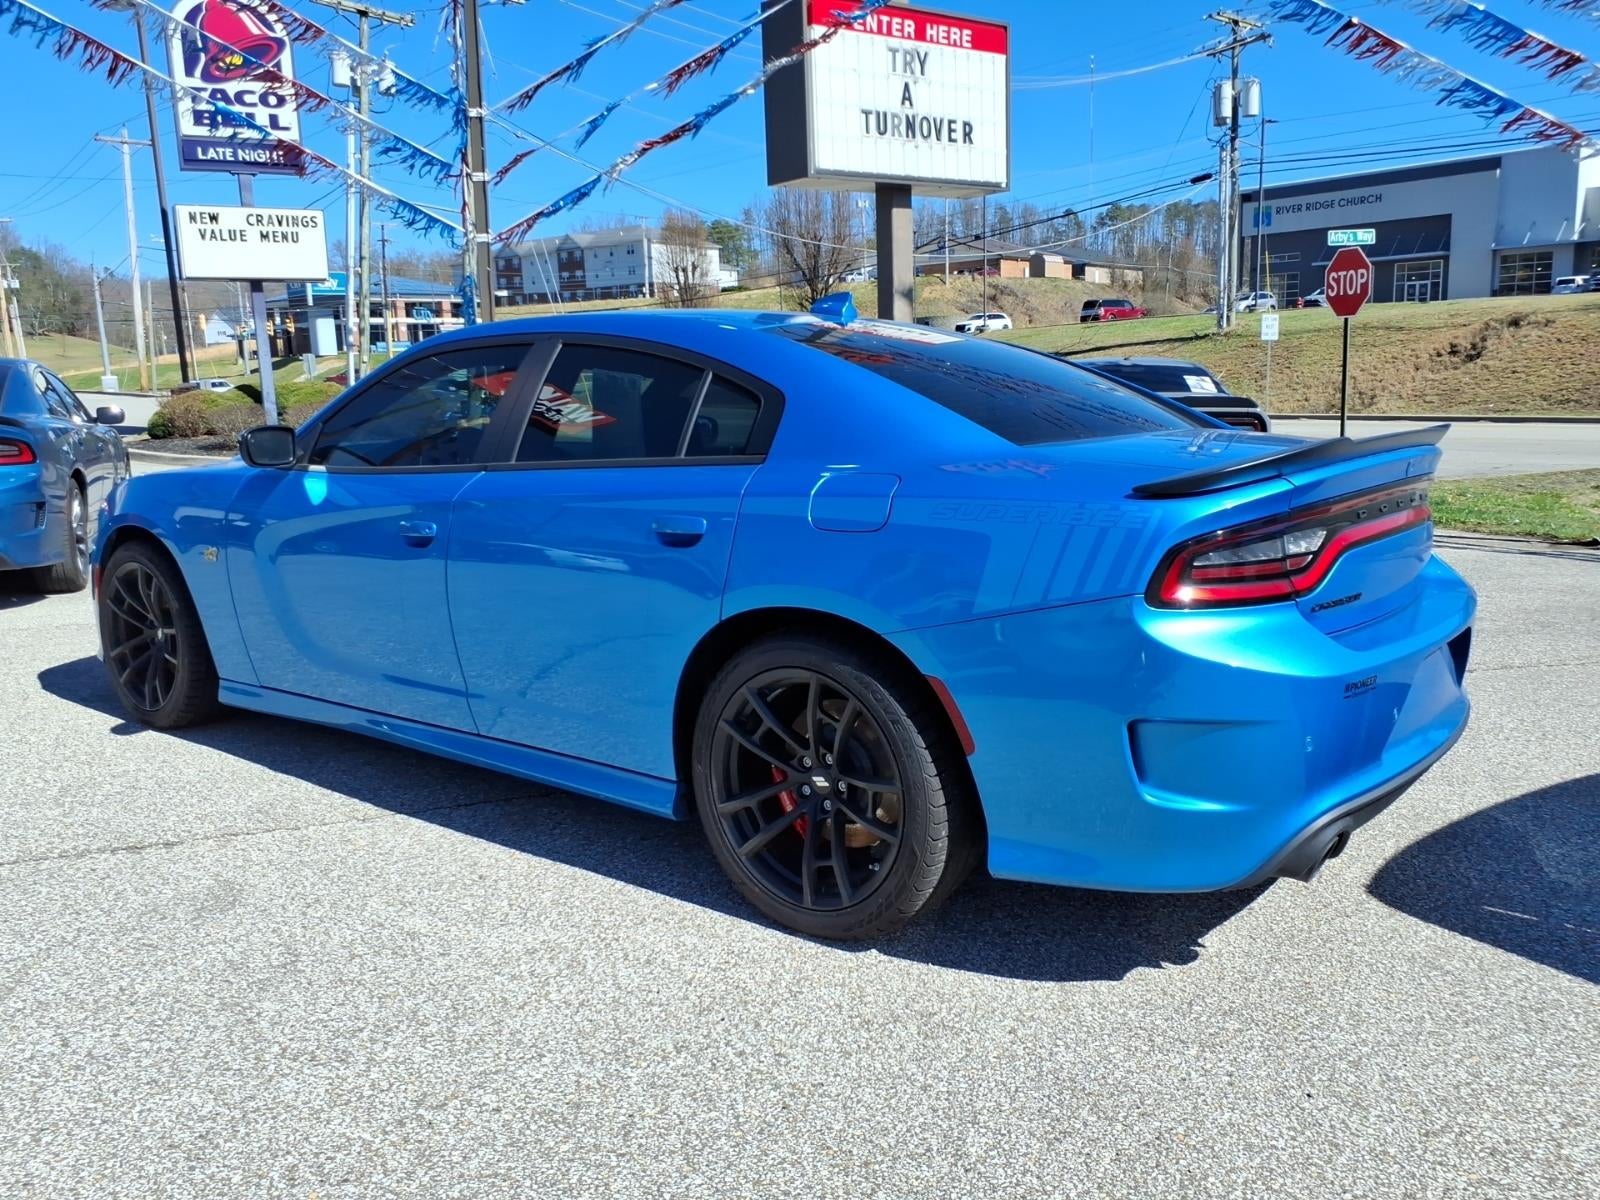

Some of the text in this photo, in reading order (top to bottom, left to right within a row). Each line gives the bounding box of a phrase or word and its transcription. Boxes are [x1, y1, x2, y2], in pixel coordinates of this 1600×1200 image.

[925, 22, 972, 48] HERE
[887, 47, 928, 76] TRY
[187, 86, 288, 109] TACO
[901, 81, 913, 107] A
[861, 108, 974, 145] TURNOVER
[196, 146, 235, 161] LATE
[1275, 193, 1382, 216] RIVER RIDGE CHURCH
[188, 211, 318, 228] NEW CRAVINGS
[198, 228, 300, 244] VALUE MENU
[1330, 231, 1354, 244] Arby's
[1328, 268, 1368, 297] STOP
[928, 502, 1151, 528] SUPER BEE
